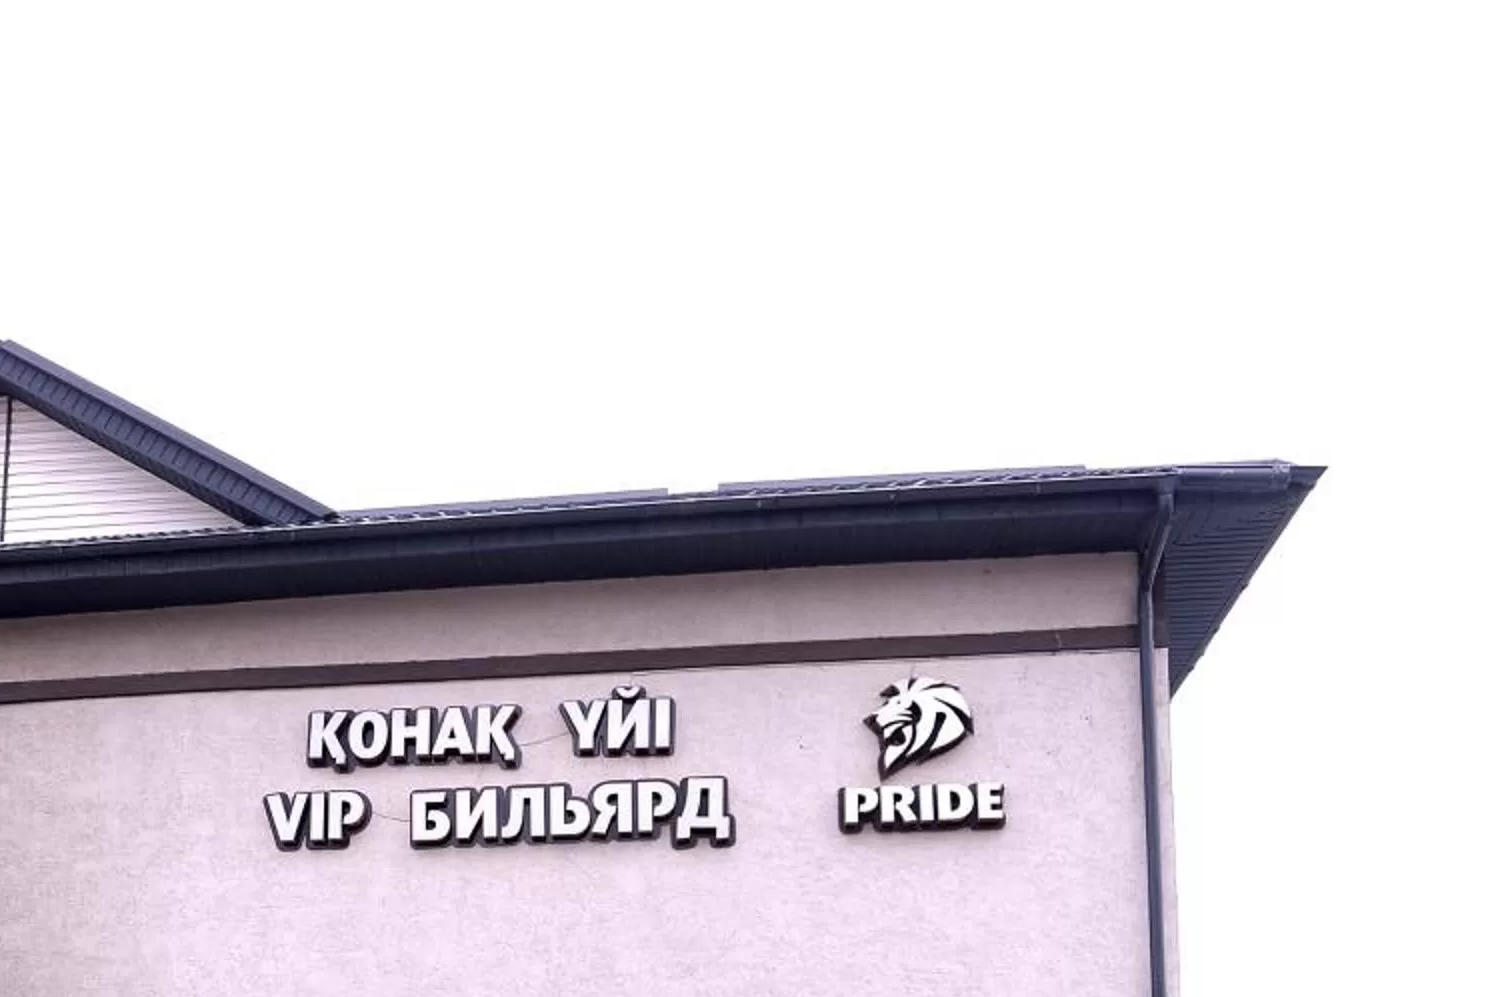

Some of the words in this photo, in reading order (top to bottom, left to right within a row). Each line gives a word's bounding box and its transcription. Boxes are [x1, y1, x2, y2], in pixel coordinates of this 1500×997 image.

[307, 704, 522, 770] ҚОНАҚ
[560, 685, 674, 755] ҮЙІ
[265, 790, 371, 848] VIP
[410, 776, 735, 848] БИЛЬЯРД
[838, 782, 1006, 833] PRIDE
